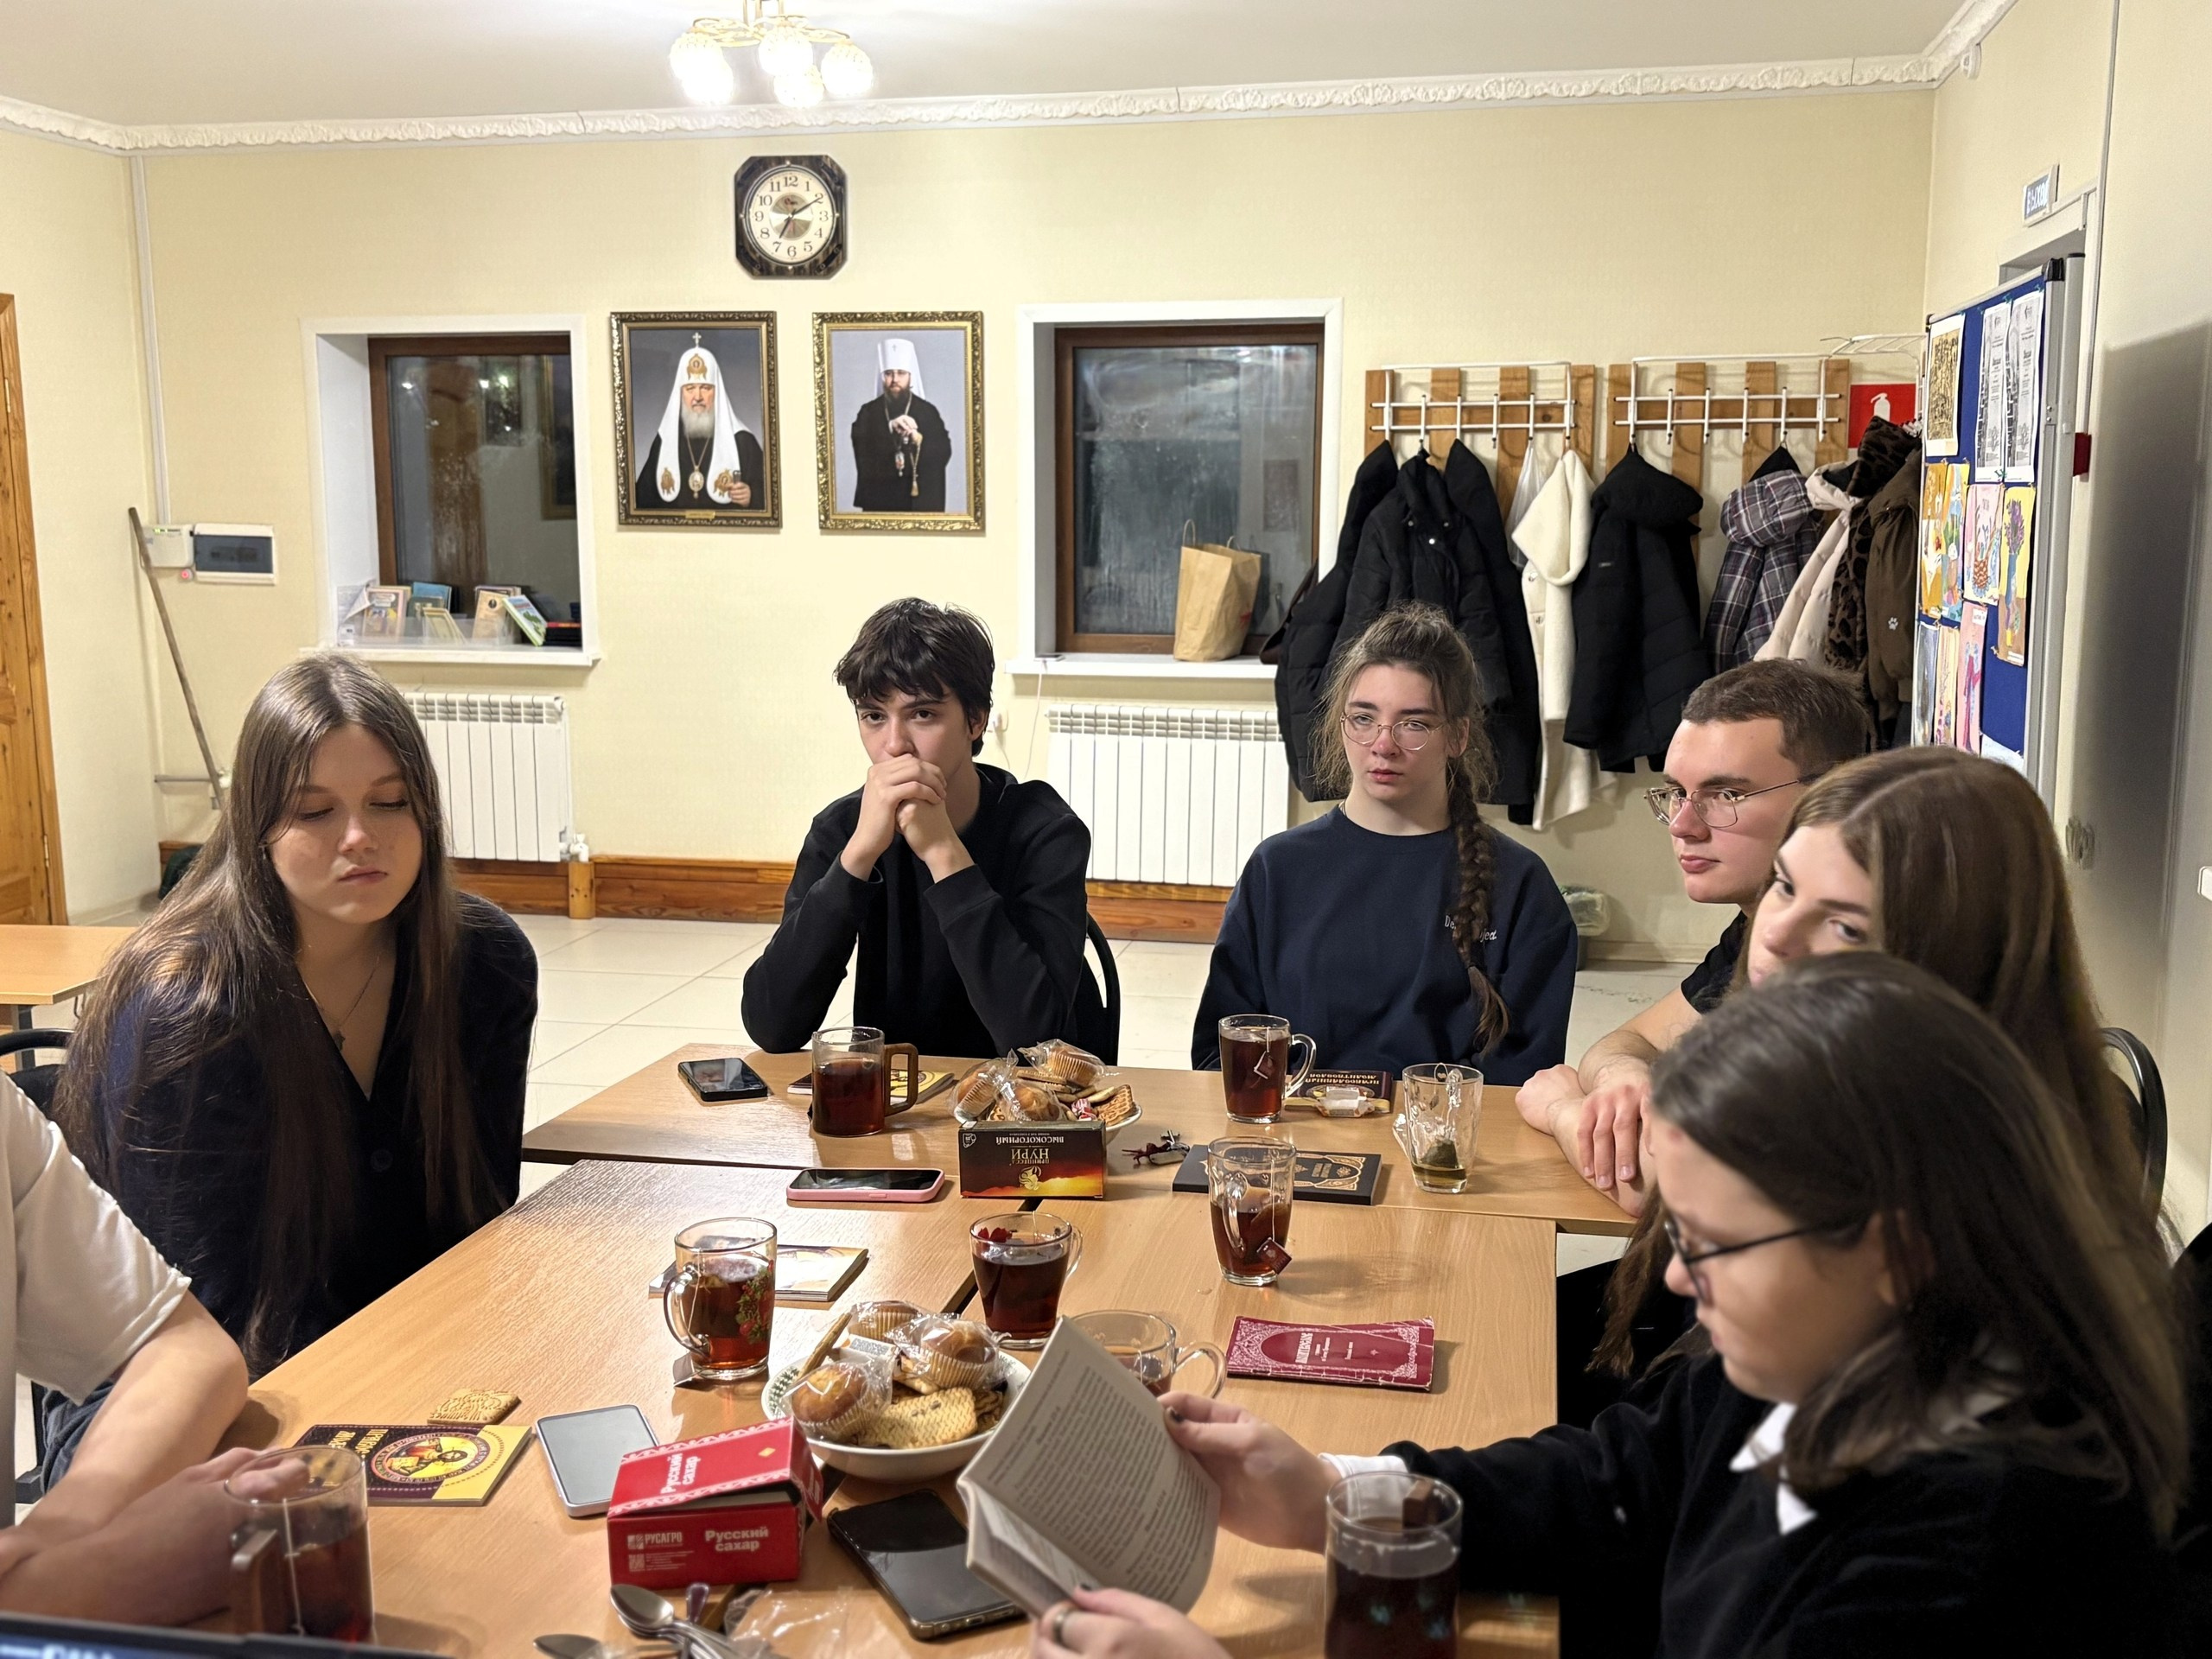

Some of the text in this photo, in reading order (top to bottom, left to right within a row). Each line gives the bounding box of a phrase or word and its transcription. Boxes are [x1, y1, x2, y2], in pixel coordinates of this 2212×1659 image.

[770, 180, 781, 193] 11
[783, 175, 798, 188] 12
[804, 181, 810, 192] 1
[760, 194, 772, 207] 10
[815, 193, 823, 205] 2
[754, 210, 764, 222] 9
[819, 210, 829, 222] 3
[760, 227, 770, 239] 8
[814, 227, 823, 238] 4
[772, 240, 782, 253] 7
[787, 245, 797, 257] 6
[804, 241, 813, 252] 5
[995, 1136, 1065, 1146] ВЫСОКОГОРНЫЙ
[1010, 1147, 1049, 1160] НУРИ
[661, 1452, 683, 1494] Русский
[682, 1456, 701, 1484] сахар
[645, 1531, 683, 1545] РУСАГРО
[704, 1526, 769, 1542] Русский
[715, 1539, 760, 1553] сахар
